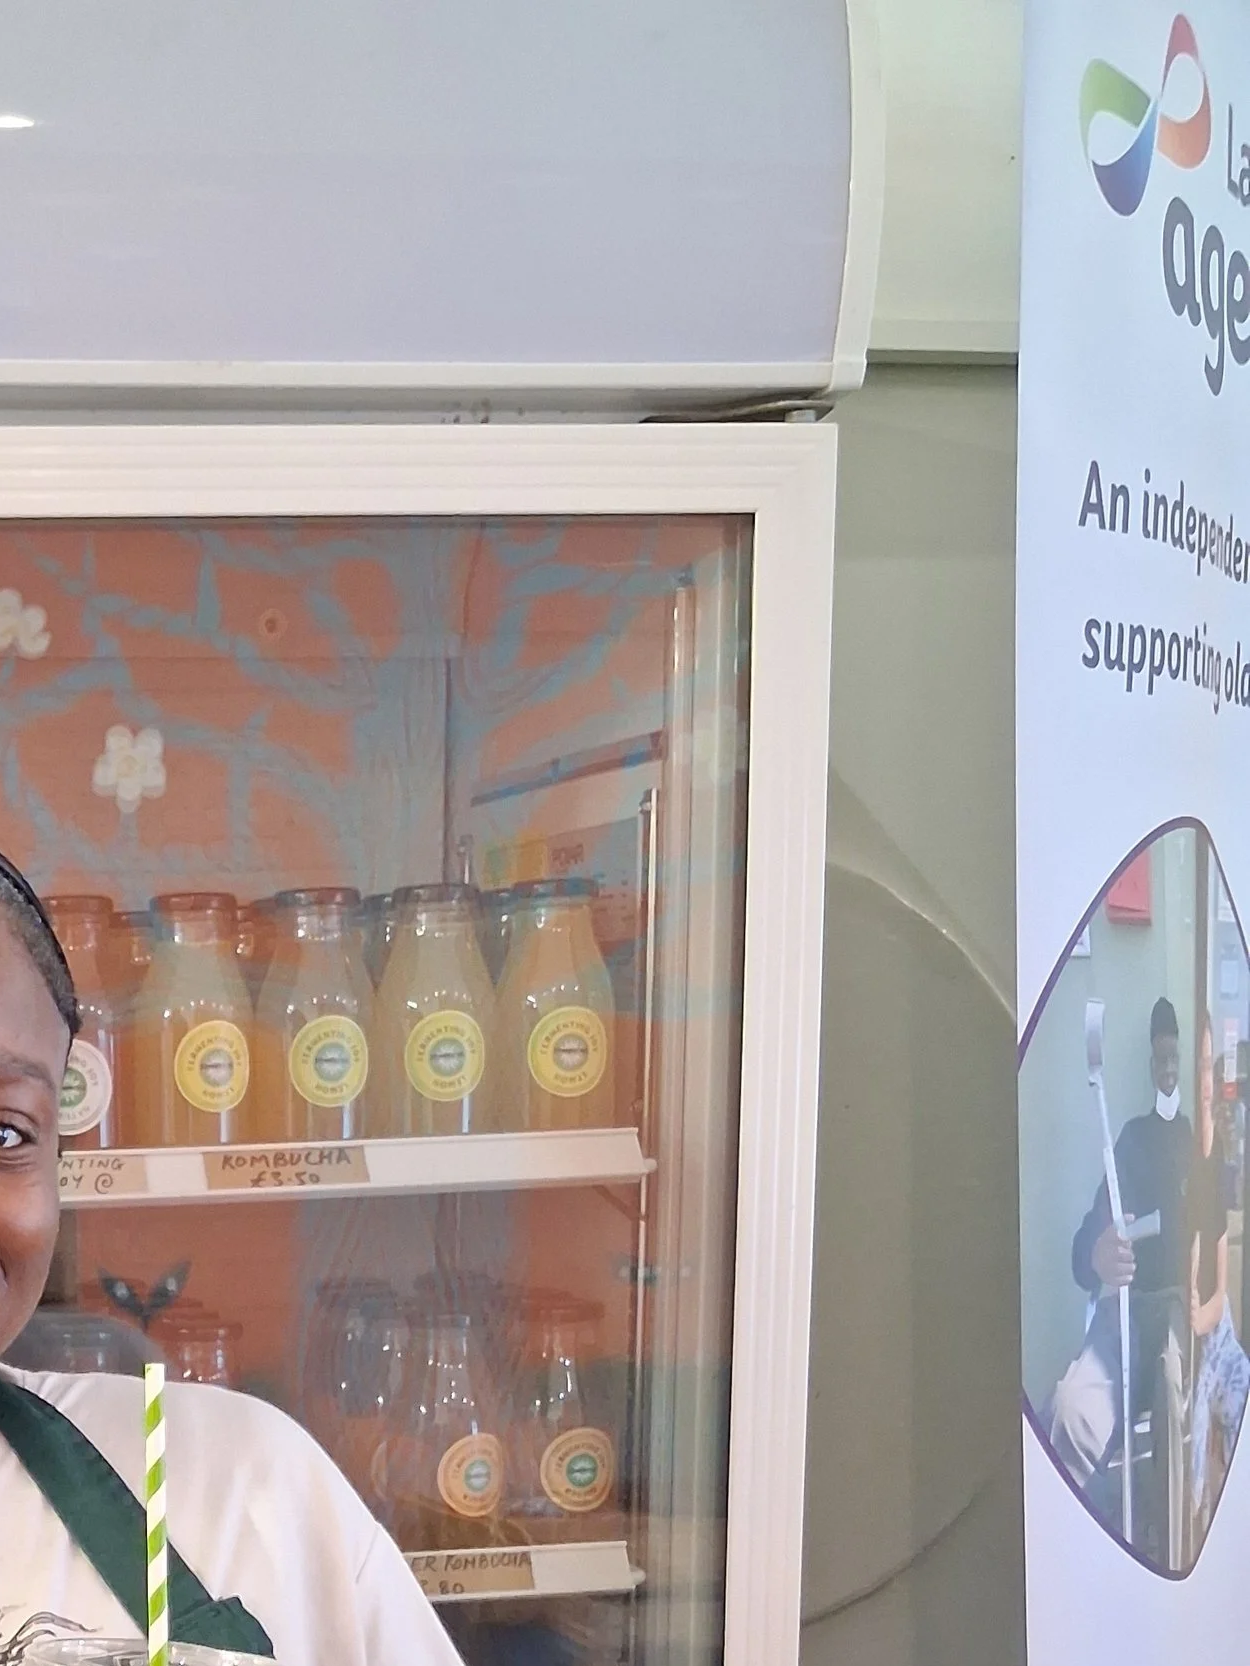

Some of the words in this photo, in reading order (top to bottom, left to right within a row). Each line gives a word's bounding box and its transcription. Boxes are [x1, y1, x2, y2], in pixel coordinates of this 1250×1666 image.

[1162, 196, 1250, 397] age
[1078, 460, 1131, 534] An
[1081, 618, 1222, 716] supporting
[58, 1157, 125, 1170] NTING
[221, 1147, 352, 1171] KOMBUCHA
